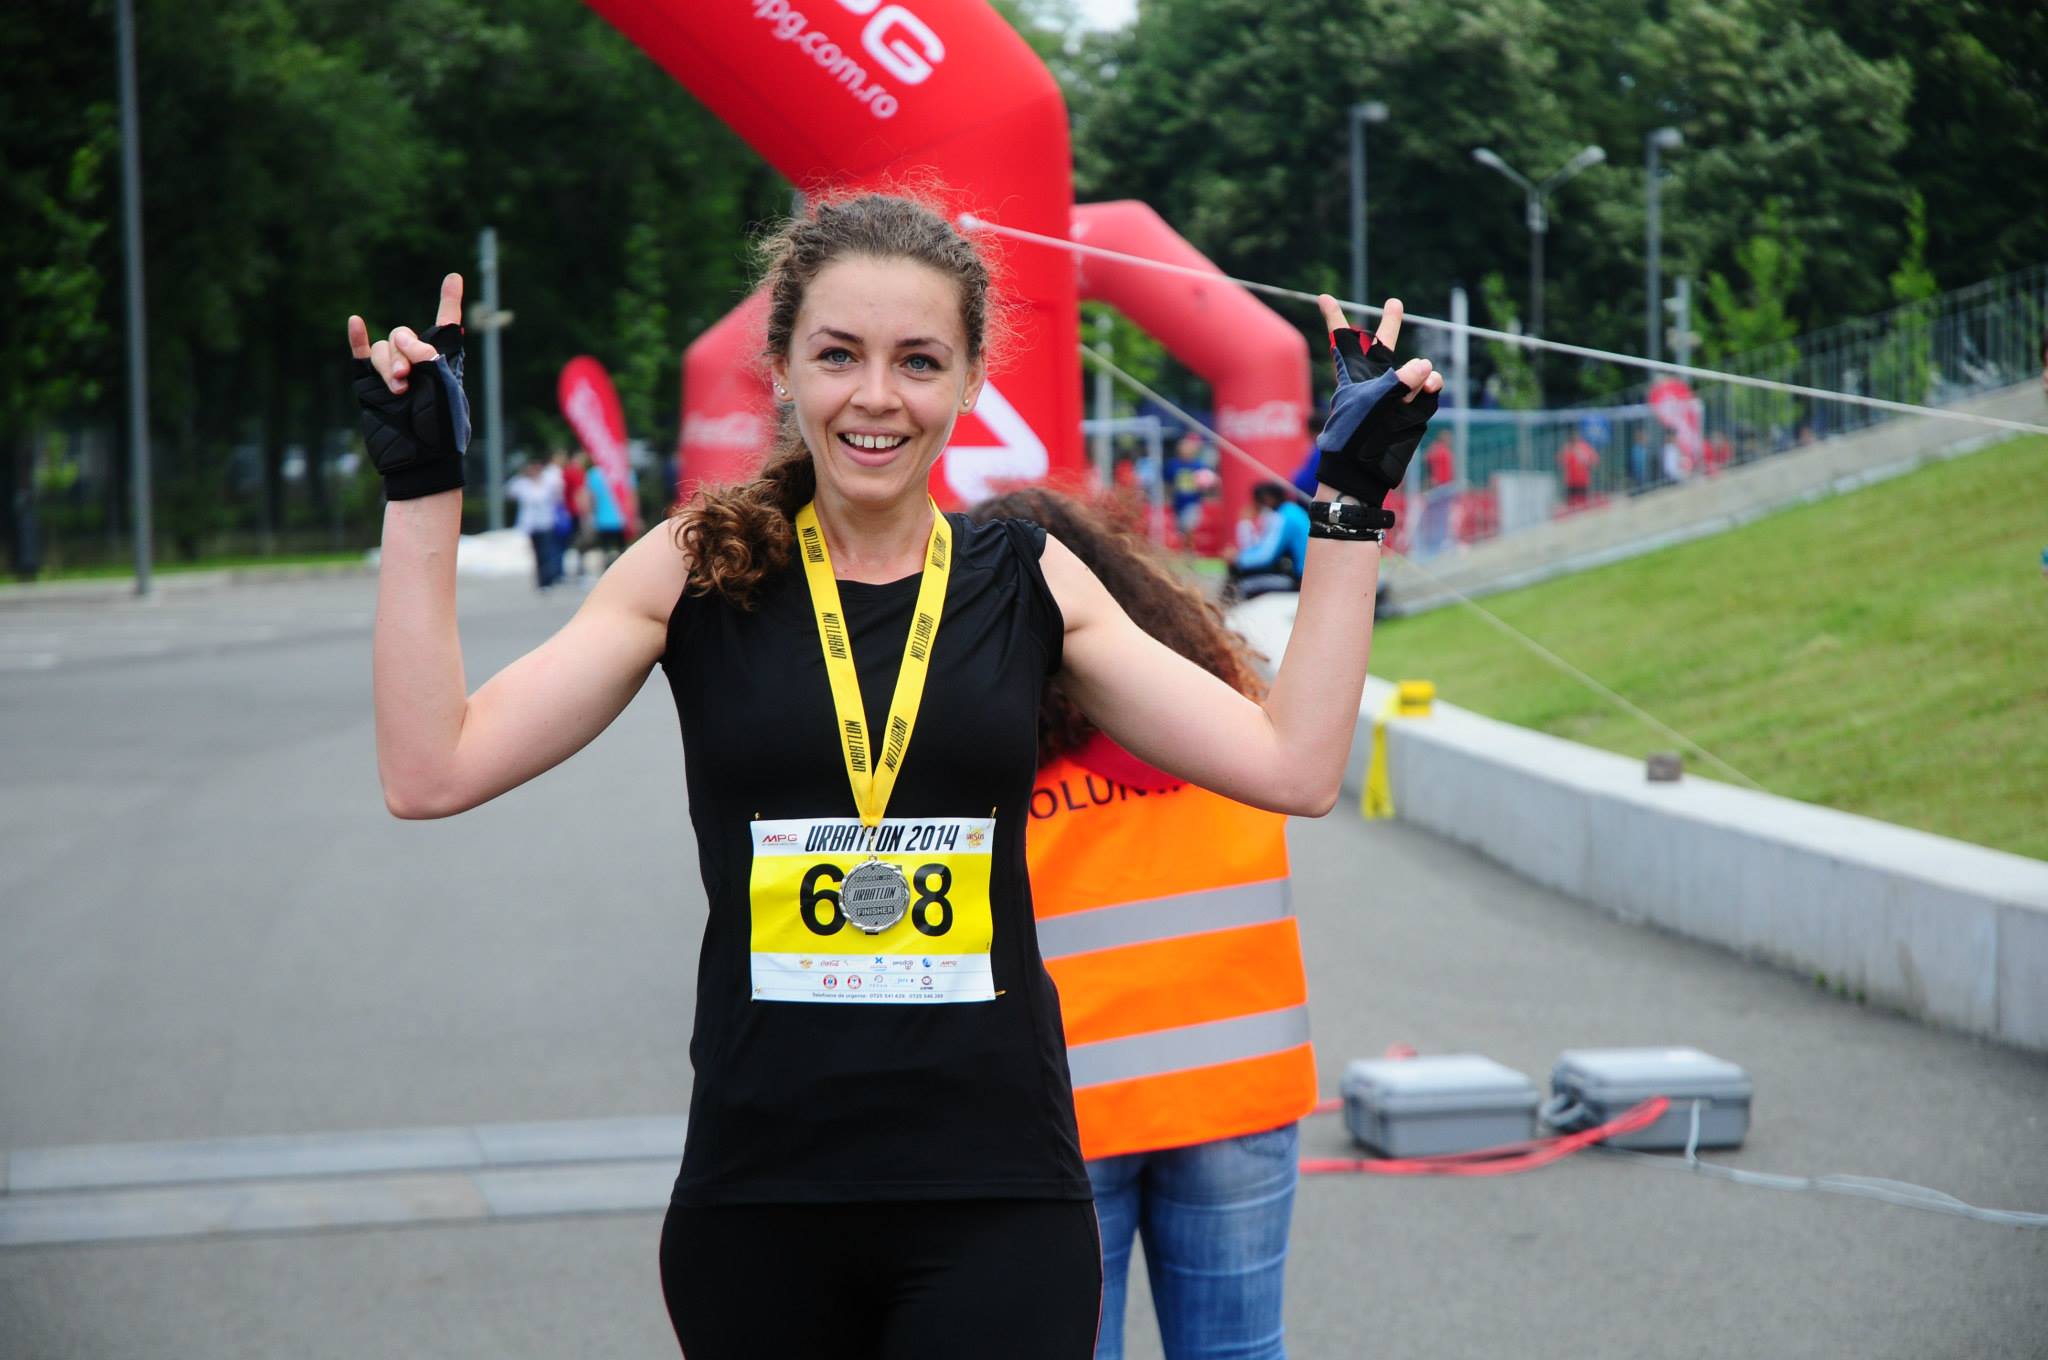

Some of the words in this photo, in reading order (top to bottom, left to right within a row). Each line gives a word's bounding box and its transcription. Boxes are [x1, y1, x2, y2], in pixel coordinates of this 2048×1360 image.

[752, 0, 899, 119] pg.com.ro
[822, 612, 847, 660] URBATLON
[909, 612, 934, 662] URBATLON
[844, 719, 867, 772] URBATLON
[884, 715, 908, 773] URBATLON
[762, 833, 798, 843] MPG
[905, 824, 960, 852] 2014
[800, 863, 954, 937] 68
